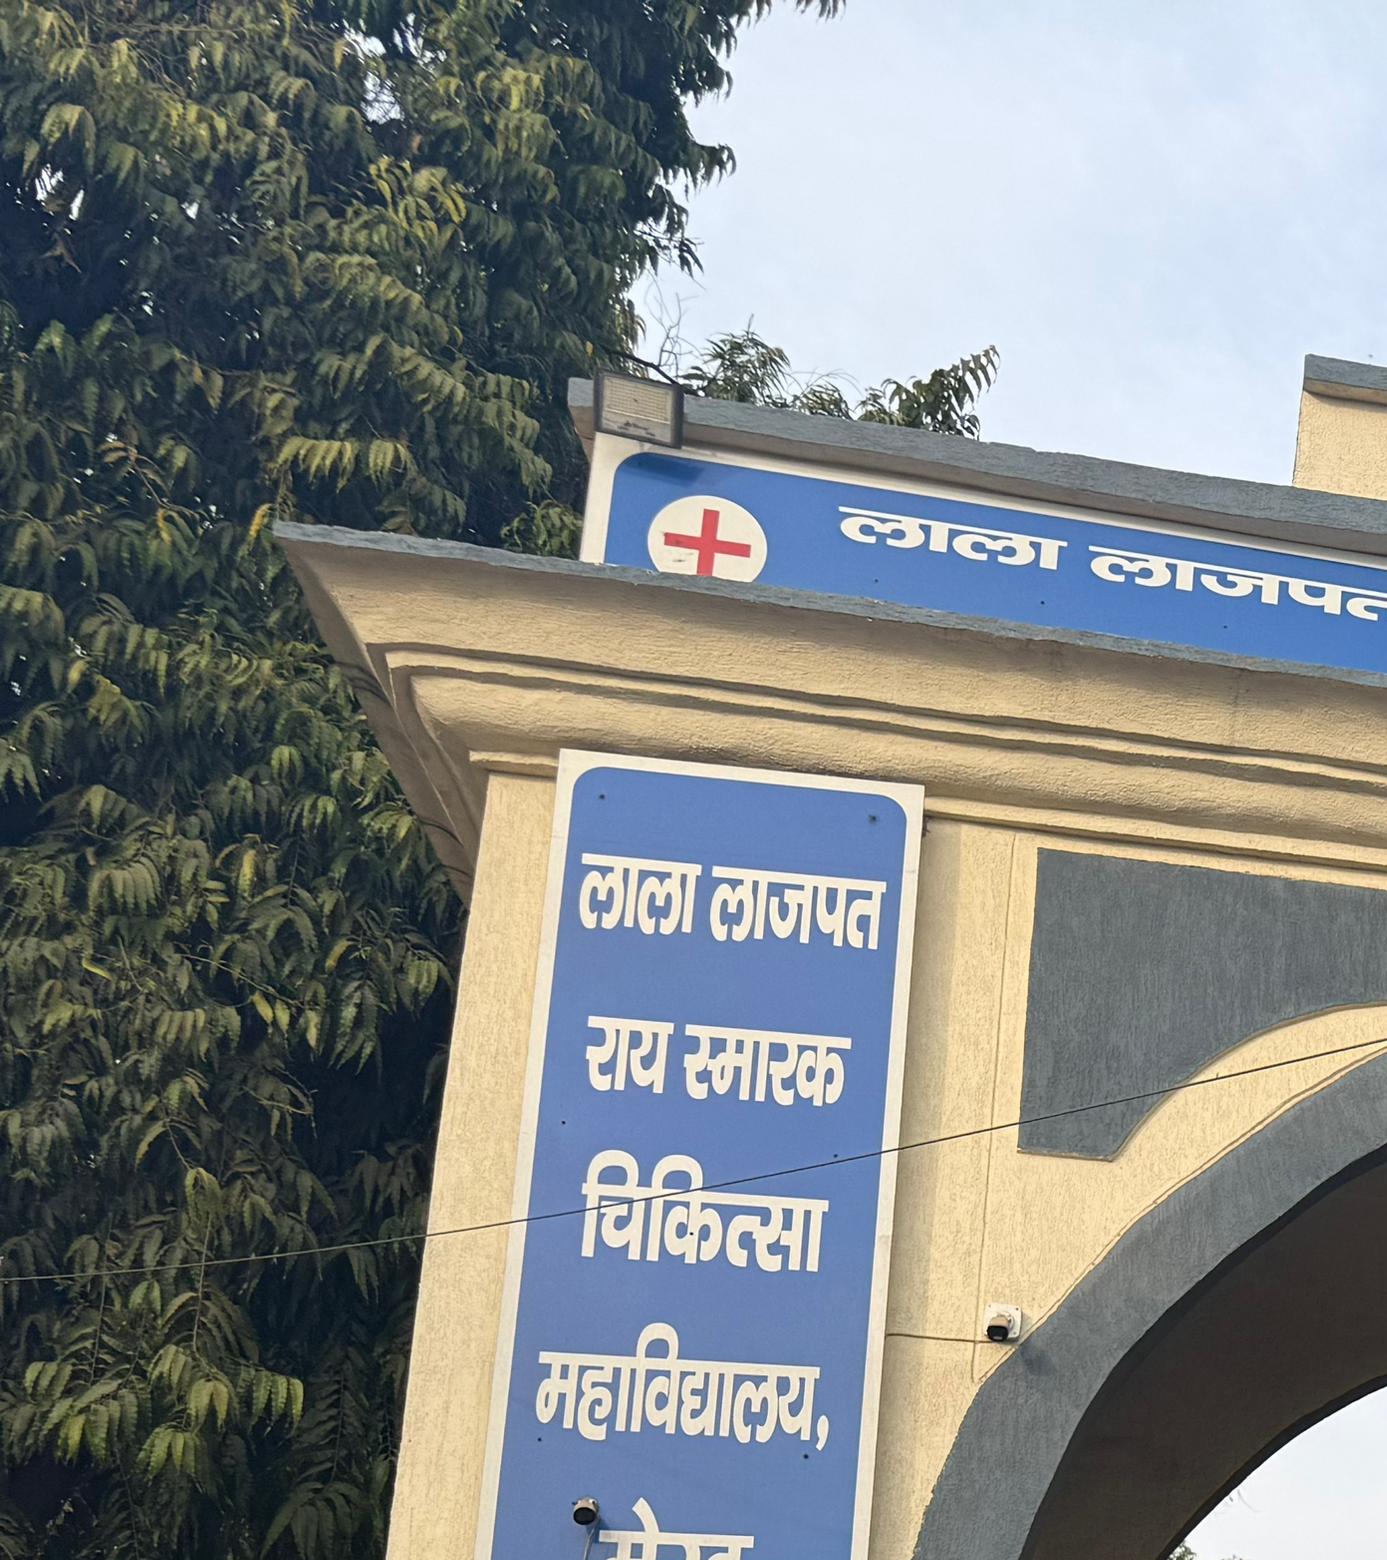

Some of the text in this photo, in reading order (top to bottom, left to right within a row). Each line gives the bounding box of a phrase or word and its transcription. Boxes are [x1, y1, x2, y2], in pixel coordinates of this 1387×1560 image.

[838, 506, 1066, 571] लाला
[579, 853, 887, 950] लाला लाजपत
[586, 1015, 852, 1106] राय स्मारक
[581, 1150, 828, 1273] चिकित्सा
[536, 1323, 830, 1451] महाविद्यालय,
